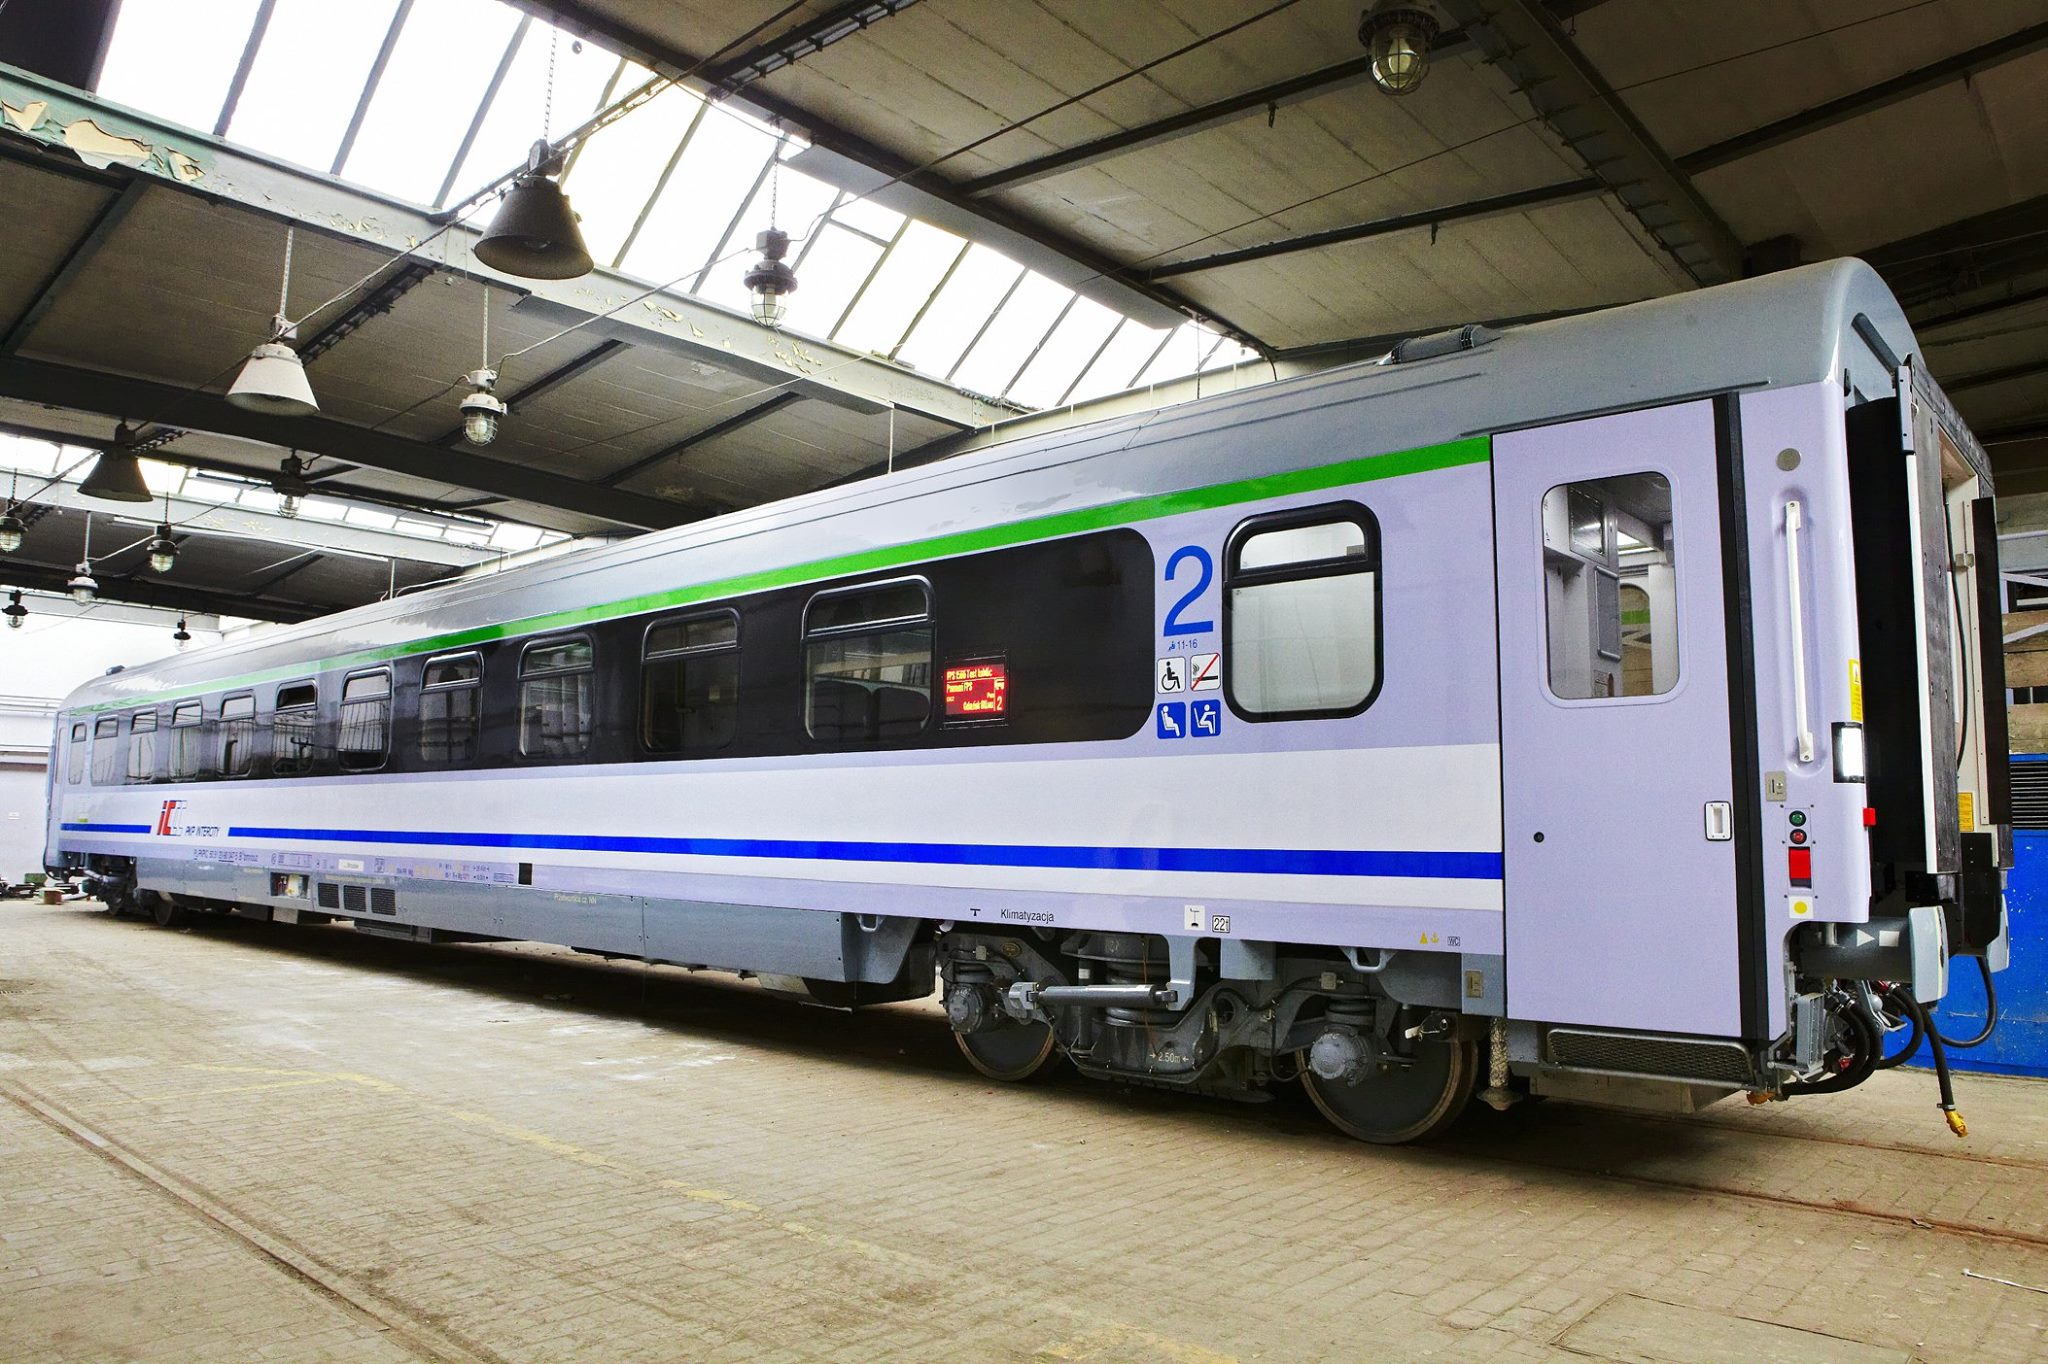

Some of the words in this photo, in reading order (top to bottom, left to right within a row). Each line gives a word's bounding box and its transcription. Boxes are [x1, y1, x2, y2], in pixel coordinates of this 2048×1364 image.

[1163, 545, 1214, 637] 2
[1177, 639, 1198, 650] 11-16
[996, 696, 1003, 711] 2
[185, 826, 196, 836] PKP
[197, 826, 221, 837] INTERCITY
[1000, 908, 1055, 922] Klimatyzacja
[1447, 936, 1460, 946] WC
